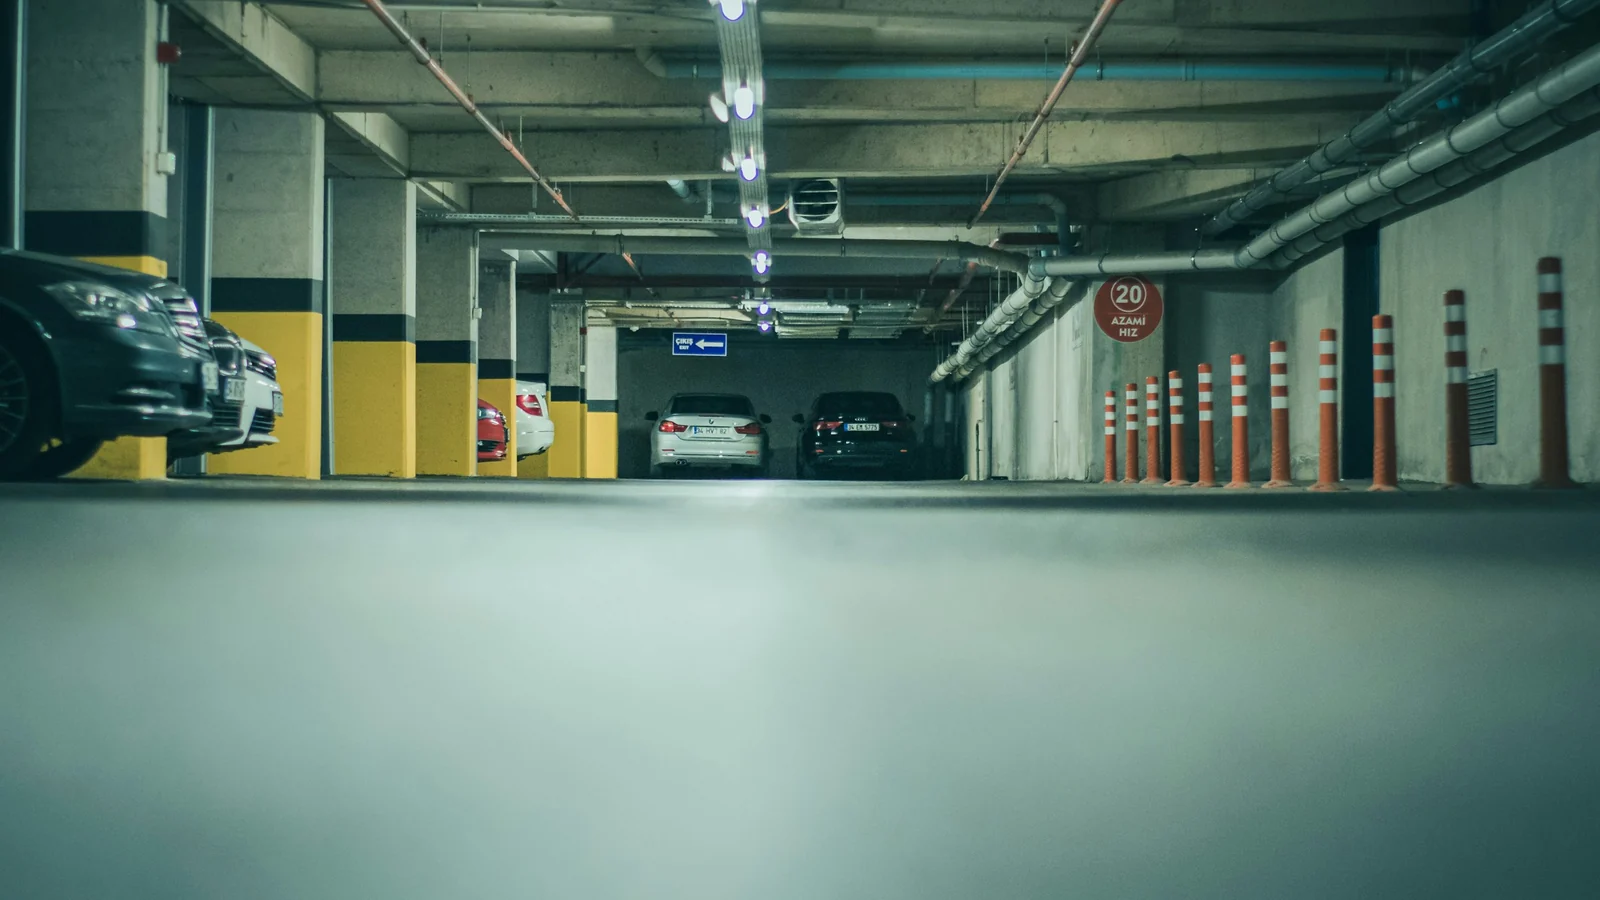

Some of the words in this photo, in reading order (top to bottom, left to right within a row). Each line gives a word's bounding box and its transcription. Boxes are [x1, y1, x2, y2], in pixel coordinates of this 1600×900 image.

[1115, 284, 1142, 304] 20
[1111, 314, 1146, 326] AZAMİ
[1119, 328, 1138, 337] HIZ
